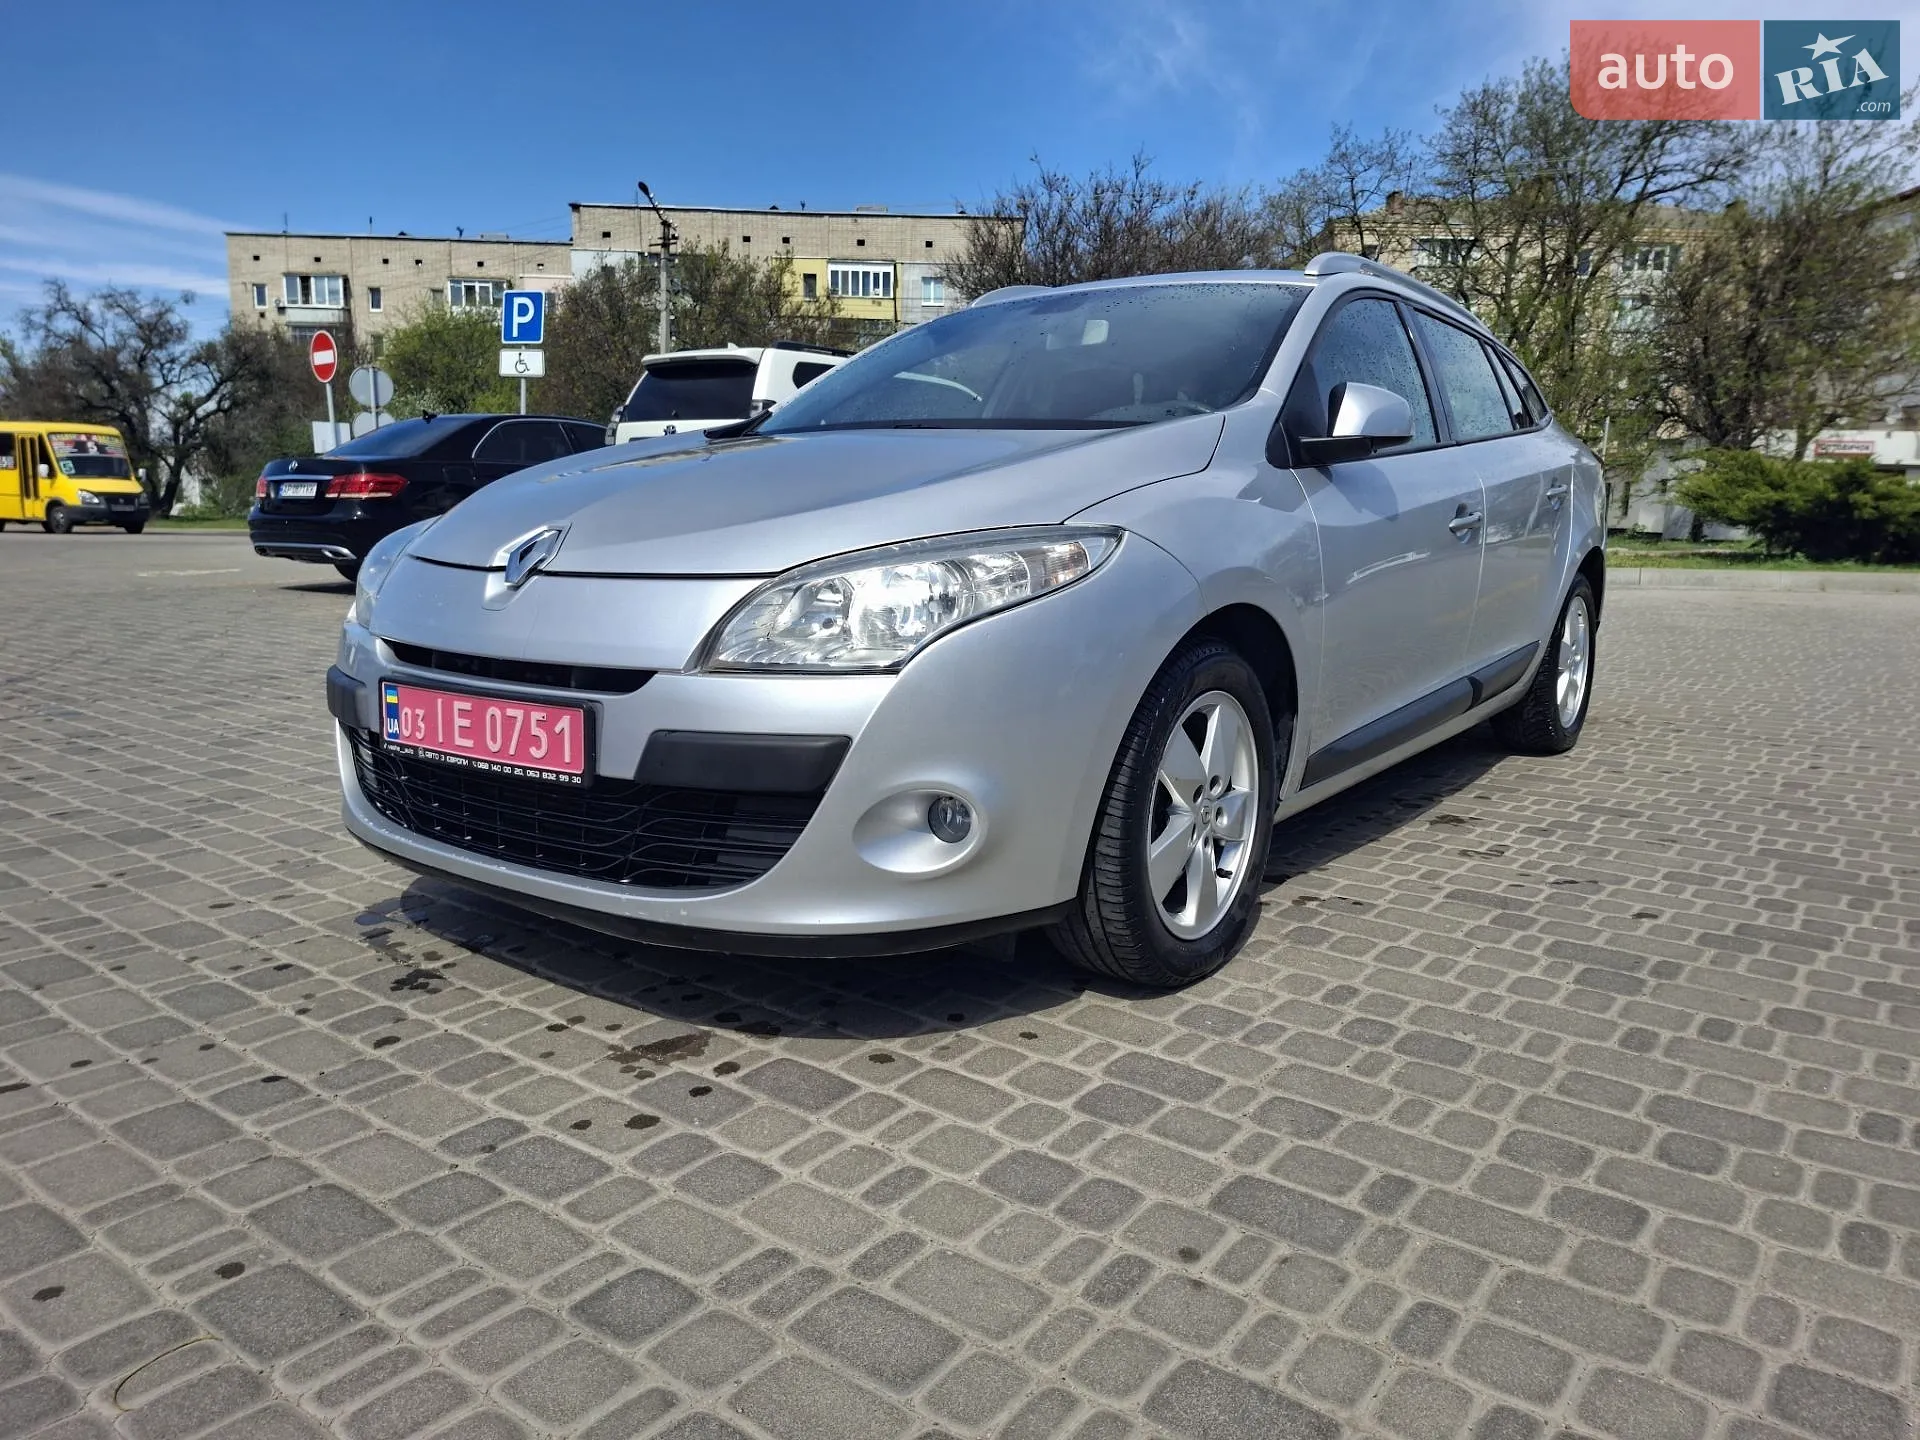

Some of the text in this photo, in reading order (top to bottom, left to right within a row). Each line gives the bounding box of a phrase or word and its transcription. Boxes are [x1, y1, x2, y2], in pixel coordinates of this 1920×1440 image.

[512, 296, 535, 338] P
[387, 717, 400, 735] UA
[401, 706, 426, 740] 03
[485, 706, 572, 763] 0751
[491, 763, 502, 772] 140
[503, 765, 512, 774] 00
[571, 776, 582, 784] 30
